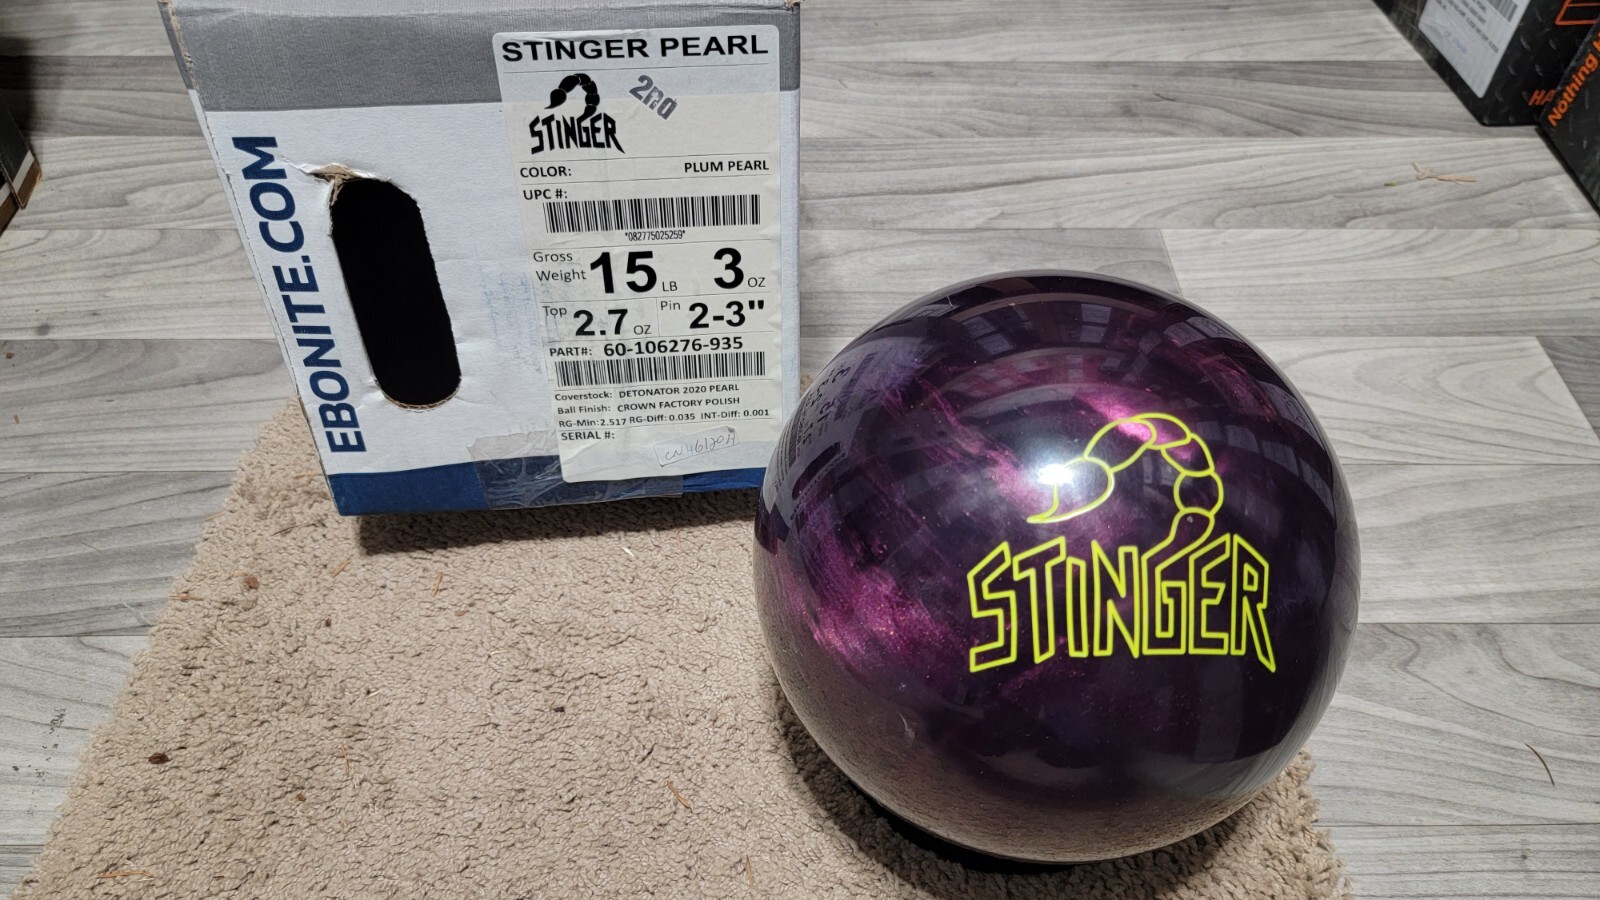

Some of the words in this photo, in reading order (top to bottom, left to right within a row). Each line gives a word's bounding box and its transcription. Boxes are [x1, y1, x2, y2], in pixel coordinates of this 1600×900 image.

[502, 38, 649, 62] STINGER
[660, 35, 768, 57] PEARL
[1548, 53, 1598, 127] Nothing
[529, 112, 625, 155] STINGER
[520, 165, 571, 178] COLOR:
[684, 161, 723, 173] PLUM
[728, 159, 769, 171] PEARL
[523, 188, 551, 200] UPC
[533, 251, 573, 263] Gross
[536, 269, 587, 282] Weight
[590, 250, 657, 294] 15
[662, 281, 678, 291] LB
[713, 247, 744, 289] 3
[747, 277, 766, 288] OZ
[231, 136, 367, 453] EBONITE.COM
[660, 300, 681, 311] Pin
[543, 305, 567, 318] Top
[573, 308, 628, 336] 2.7
[633, 324, 652, 335] OZ
[549, 346, 592, 357] PART#:
[604, 336, 743, 356] 60-106276-935
[555, 390, 613, 401] Coverstock:
[619, 386, 680, 398] DETONATOR
[683, 385, 707, 394] 2020
[709, 383, 740, 393] PEARL
[558, 406, 576, 415] Ball
[579, 404, 611, 414] Finish:
[617, 402, 656, 413] CROWN
[659, 398, 703, 409] FACTORY
[705, 397, 740, 406] POLISH
[701, 410, 741, 420] INT-Diff:
[743, 408, 770, 417] 0.001
[561, 430, 601, 441] SERIAL
[967, 533, 1275, 673] STINGER
